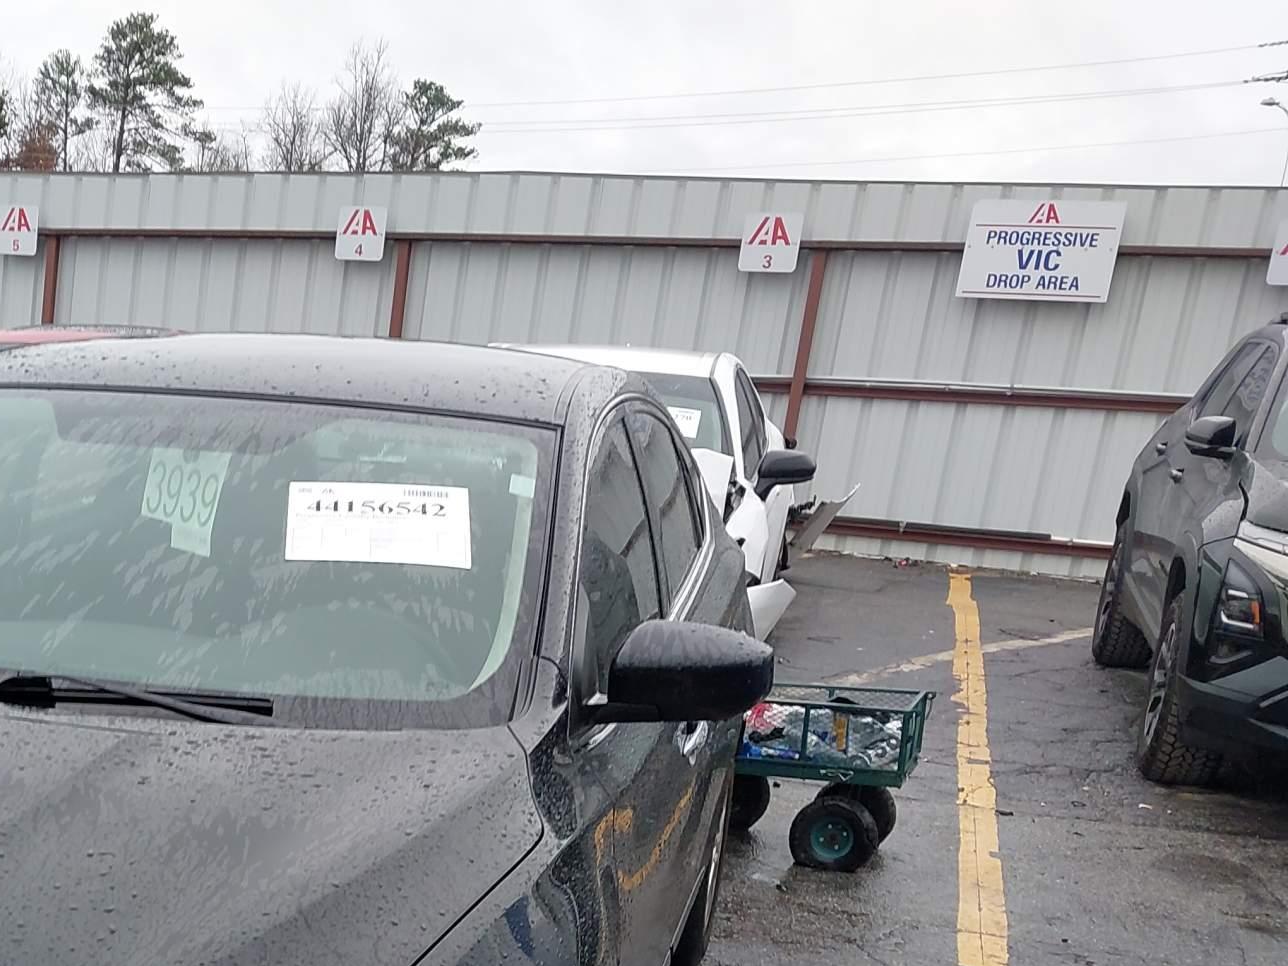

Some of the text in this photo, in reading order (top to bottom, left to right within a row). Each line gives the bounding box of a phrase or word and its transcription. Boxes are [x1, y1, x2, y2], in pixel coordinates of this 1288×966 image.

[12, 239, 20, 252] 5
[986, 230, 1100, 248] PROGRESSIVE
[354, 243, 363, 256] 4
[762, 254, 773, 269] 3
[1017, 249, 1062, 271] VIC
[986, 273, 1080, 291] DROP AREA
[146, 460, 219, 527] 3939
[306, 500, 447, 517] 44156542
